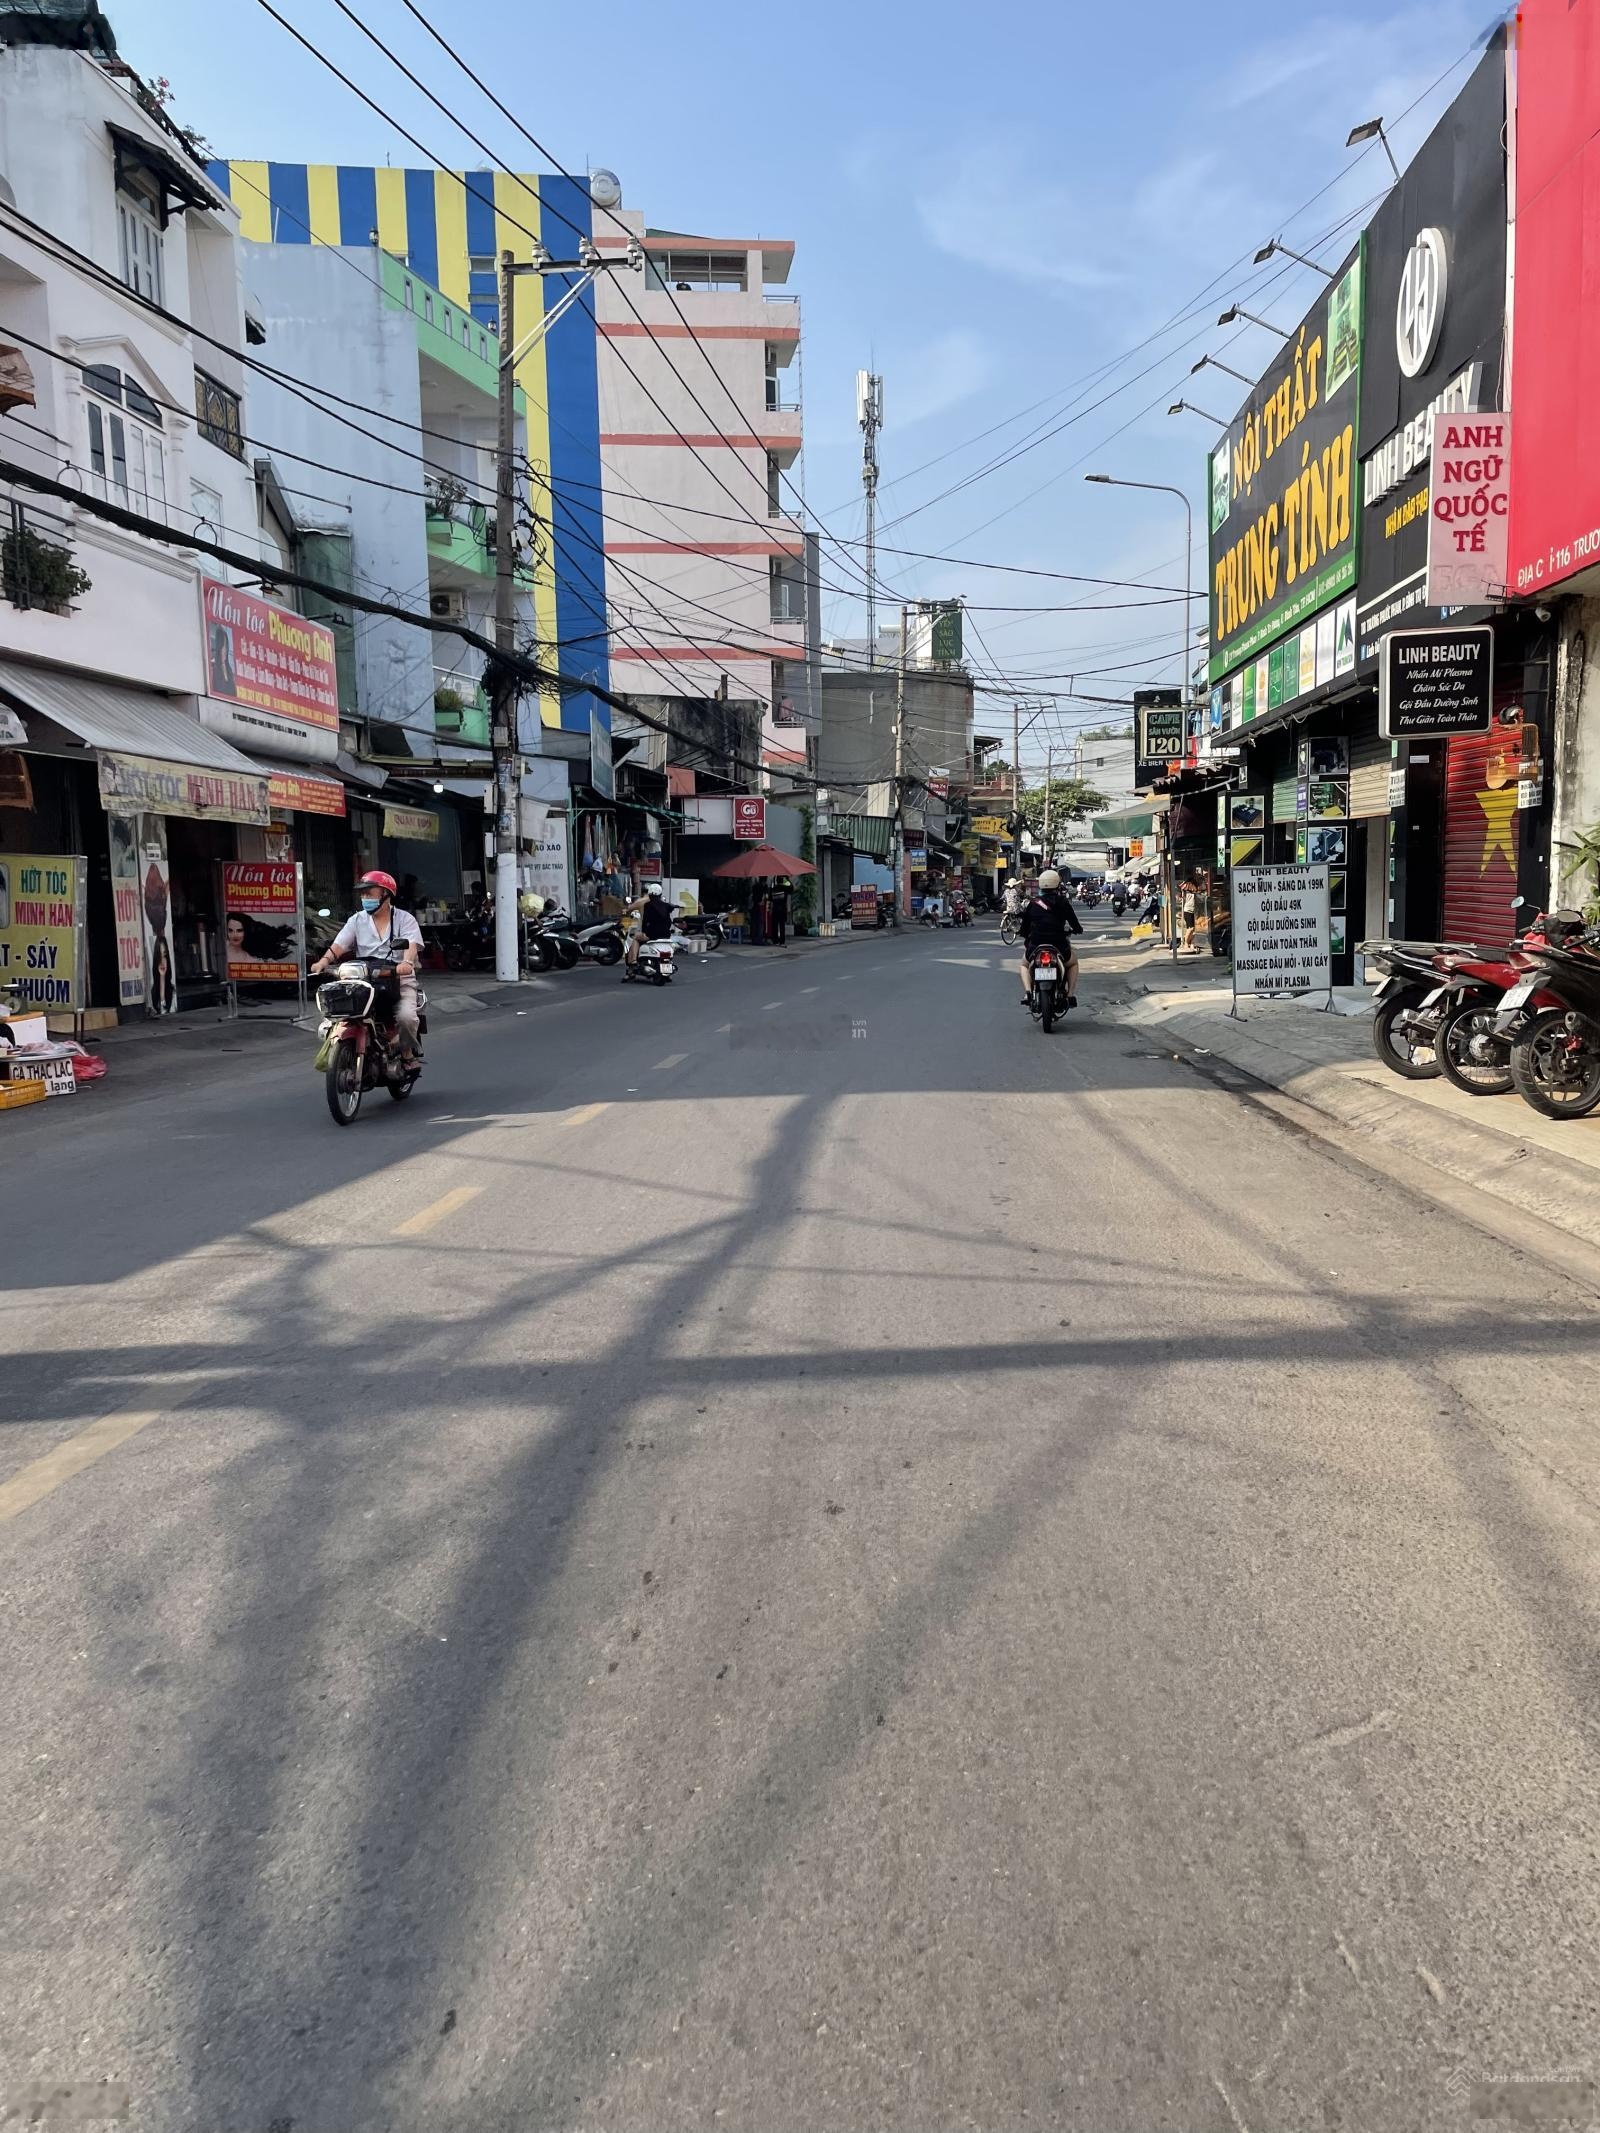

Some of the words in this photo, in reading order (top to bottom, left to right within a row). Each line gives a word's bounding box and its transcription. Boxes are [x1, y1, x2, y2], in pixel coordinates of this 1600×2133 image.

[1233, 412, 1261, 499] NỘI
[1263, 326, 1322, 459] THẤT
[1443, 426, 1503, 448] ANH
[1364, 433, 1403, 508] LINH
[1443, 455, 1503, 483] NGỮ
[1434, 484, 1508, 523] QUỐC
[1215, 503, 1280, 642] TRUNG
[1283, 424, 1353, 585] TÍNH
[1453, 519, 1487, 552] TẾ
[1517, 564, 1534, 589] ĐỊA
[1556, 545, 1571, 570] 116
[245, 607, 265, 636] tóc
[313, 631, 334, 664] Anh
[1399, 647, 1429, 665] LINH
[1431, 643, 1480, 663] BEAUTY
[1406, 668, 1428, 680] Nhấn
[1430, 668, 1442, 678] Mí
[1443, 667, 1473, 678] Plasma
[1412, 683, 1436, 693] Chăm
[1438, 682, 1452, 692] Sóc
[1452, 681, 1465, 690] Da
[1399, 700, 1413, 711] Gội
[1461, 696, 1479, 706] Sinh
[1399, 715, 1415, 725] Thư
[1436, 713, 1456, 723] Toàn
[1458, 712, 1477, 722] Thân
[1148, 736, 1180, 754] 120
[46, 866, 67, 895] TÓC
[227, 864, 264, 883] Uốn
[270, 868, 294, 883] tóc
[1251, 867, 1271, 877] LINH
[1276, 866, 1311, 876] BEAUTY
[273, 884, 293, 897] Anh
[1238, 882, 1256, 896] SẠCH
[1277, 878, 1296, 892] SÁNG
[1297, 879, 1307, 891] DA
[1308, 878, 1324, 890] 199K
[15, 901, 46, 927] MINH
[49, 898, 73, 928] HÂN
[1261, 898, 1273, 914] GỘI
[1289, 899, 1302, 911] 49K
[1247, 918, 1260, 934] GỘI
[1300, 918, 1317, 929] SINH
[1247, 938, 1261, 951] THƯ
[1280, 935, 1298, 949] TOÀN
[1299, 934, 1318, 948] THÂN
[26, 937, 58, 969] SẤY
[1236, 958, 1268, 971] MASSAGE
[1301, 956, 1313, 968] VAI
[1314, 953, 1329, 967] GÁY
[1284, 975, 1311, 988] PLASMA
